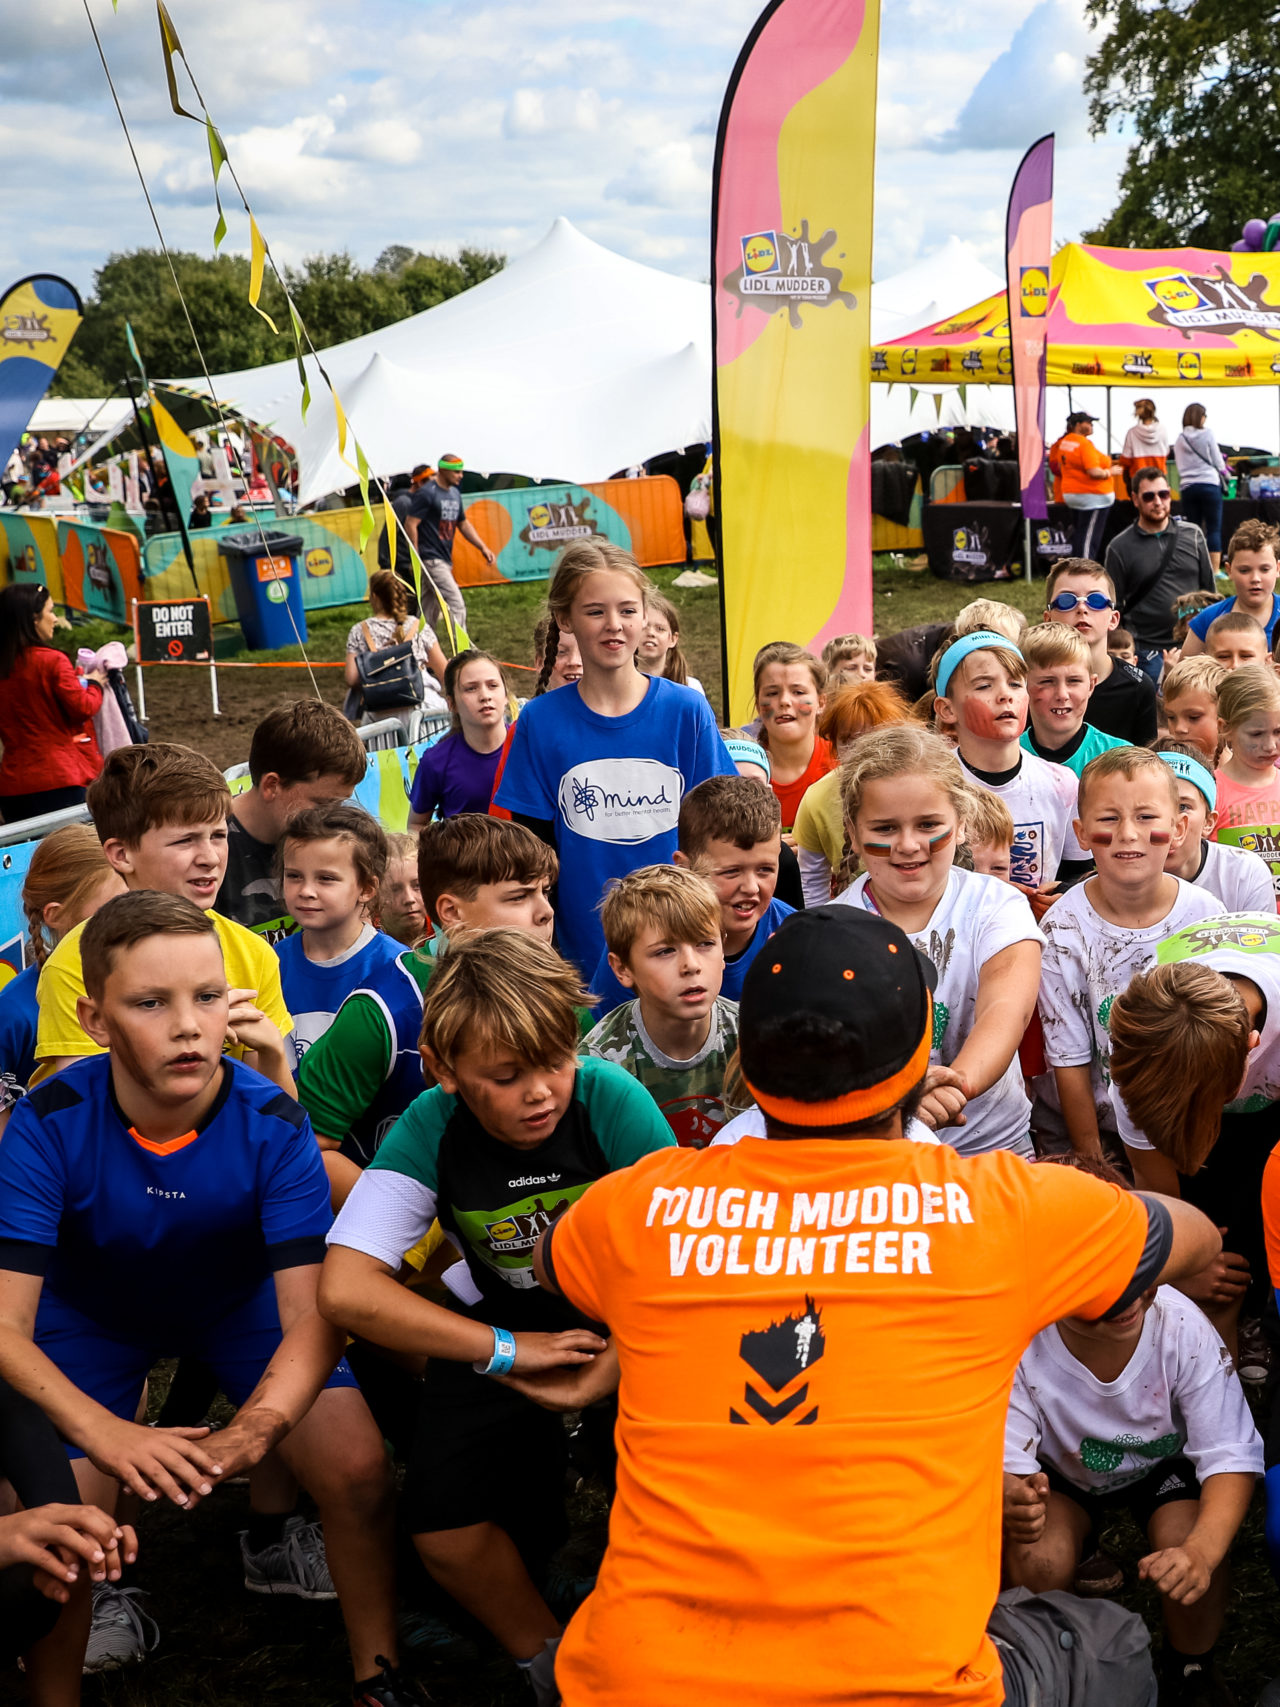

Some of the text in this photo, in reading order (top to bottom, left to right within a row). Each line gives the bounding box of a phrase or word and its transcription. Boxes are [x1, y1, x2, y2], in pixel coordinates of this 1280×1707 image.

[743, 279, 825, 291] LIDL MUDDER
[552, 527, 589, 537] MUDDER
[152, 605, 194, 622] DO NOT
[155, 621, 193, 637] ENTER
[603, 784, 672, 809] mind
[615, 809, 631, 817] better
[633, 807, 651, 816] mental
[508, 1175, 547, 1188] adidas
[146, 1186, 186, 1199] KIPSTA
[645, 1182, 975, 1233] TOUGH MUDDER
[494, 1240, 520, 1250] LIDL
[669, 1231, 933, 1277] VOLUNTEER
